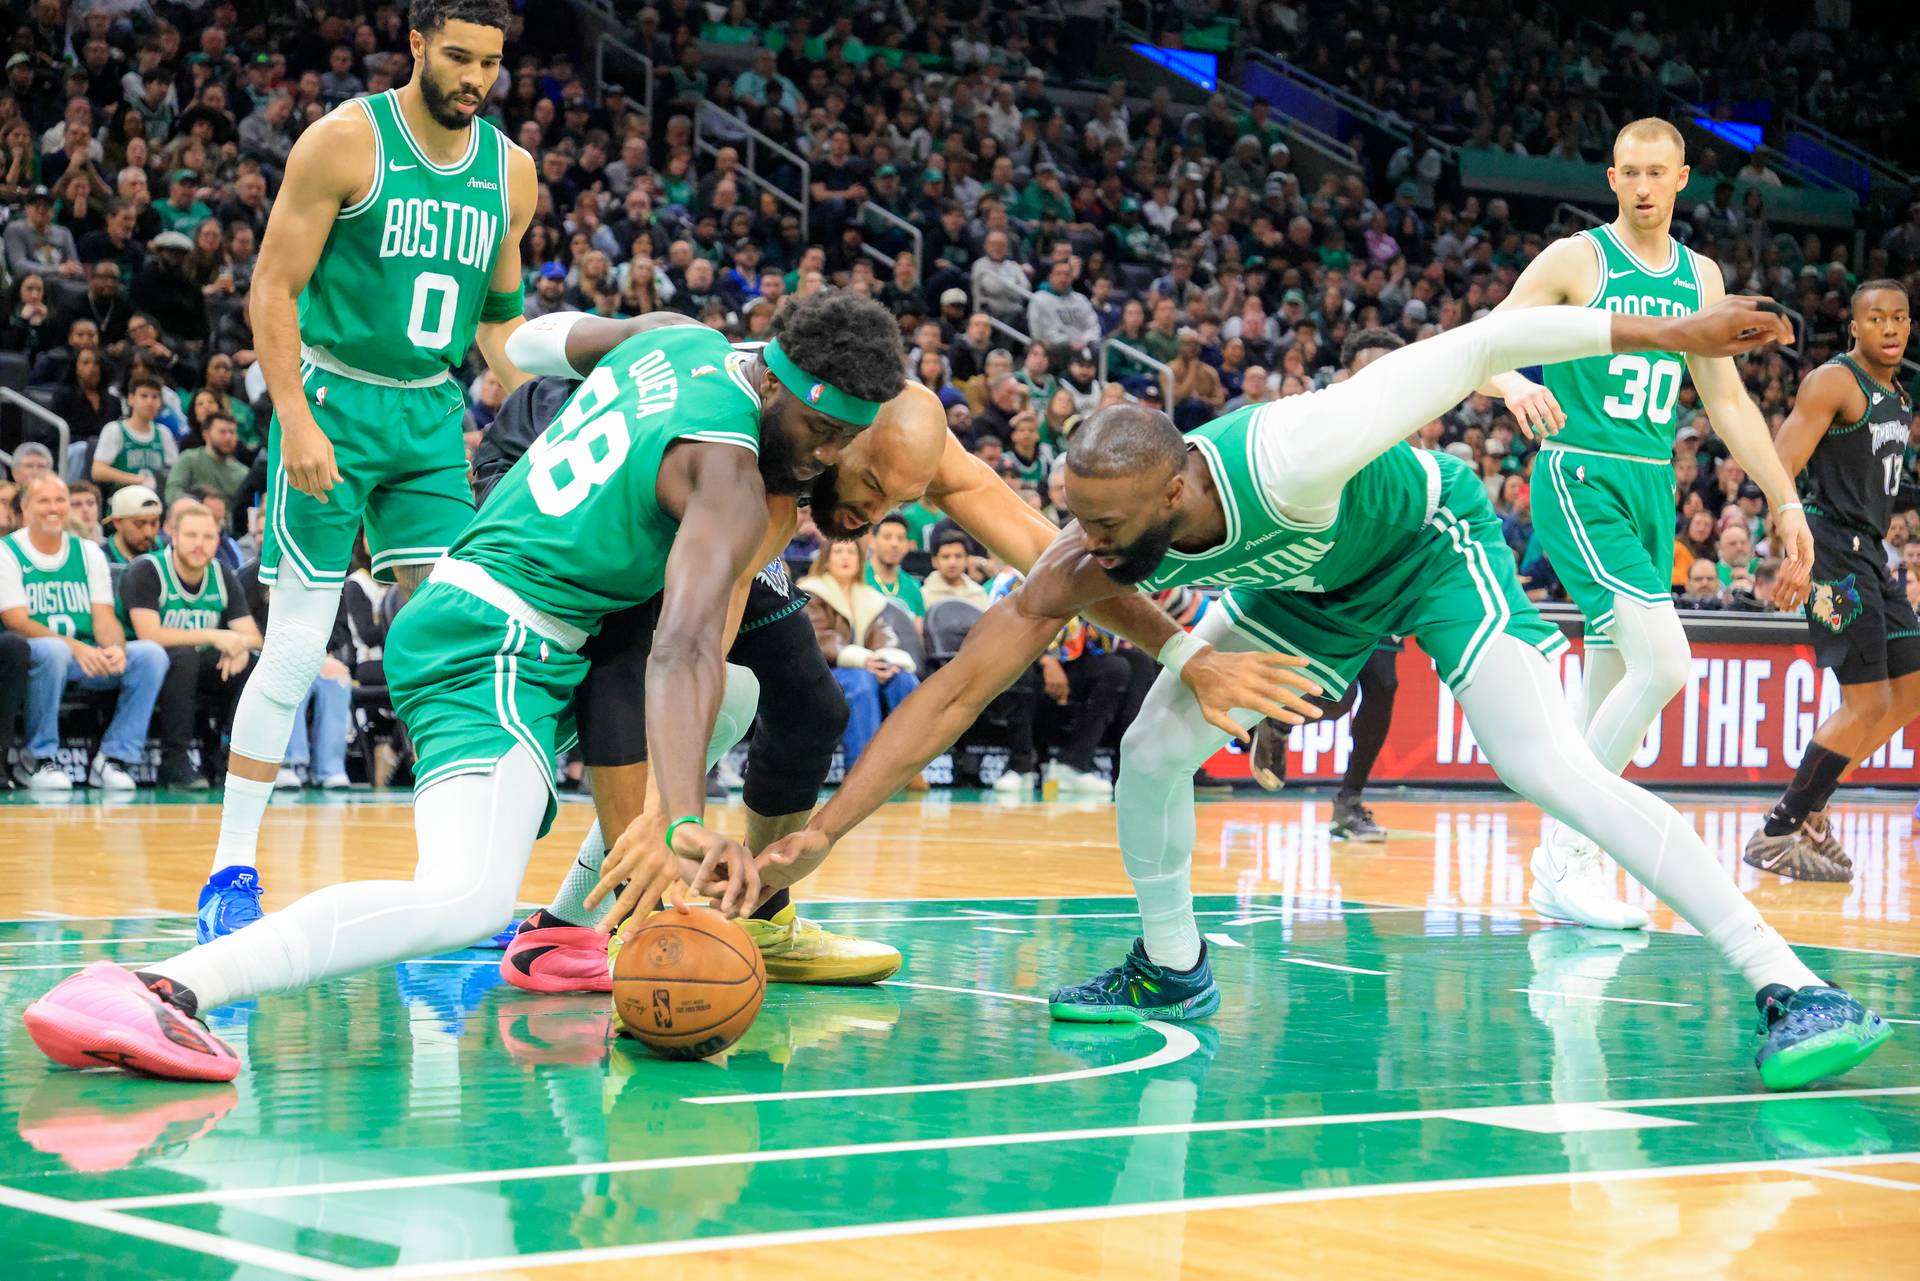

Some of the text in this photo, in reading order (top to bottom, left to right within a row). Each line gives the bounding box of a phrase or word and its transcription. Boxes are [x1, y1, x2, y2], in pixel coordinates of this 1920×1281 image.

[466, 176, 498, 191] Amica
[379, 197, 498, 273] BOSTON
[407, 271, 460, 350] 0
[628, 349, 679, 420] QUETA
[1603, 354, 1683, 425] 30
[526, 366, 632, 518] 88
[1244, 529, 1284, 551] Amica
[25, 581, 92, 616] BOSTON
[1682, 658, 1771, 768] THE
